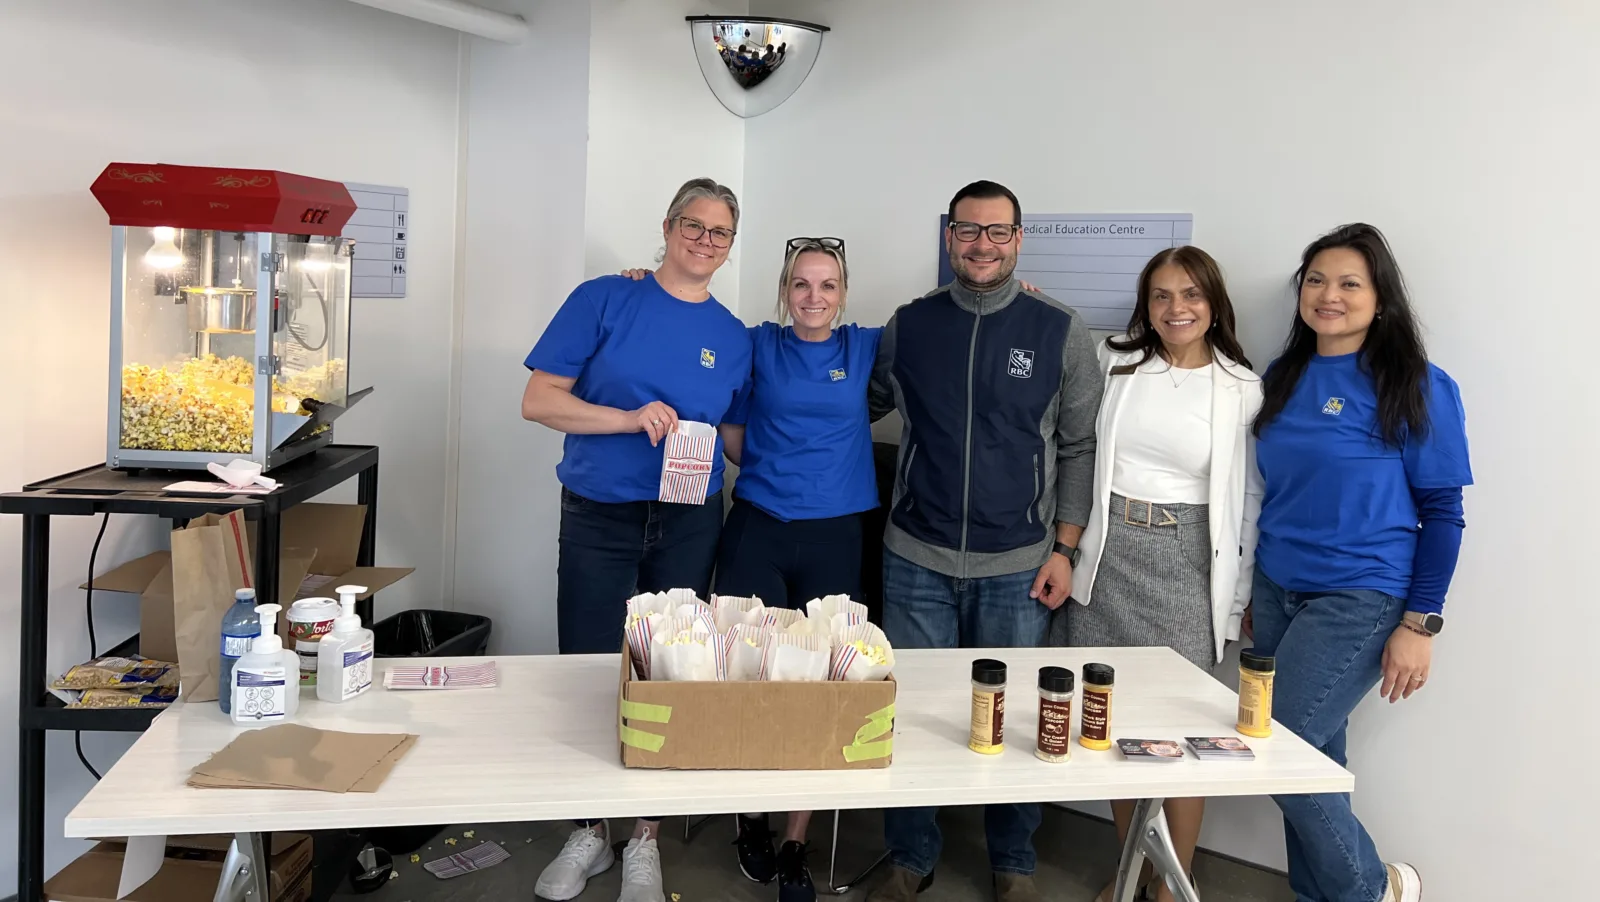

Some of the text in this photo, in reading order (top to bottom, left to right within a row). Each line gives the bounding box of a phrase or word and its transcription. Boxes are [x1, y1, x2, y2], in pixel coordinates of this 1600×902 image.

[1022, 223, 1146, 235] edical Education Centre
[1010, 367, 1030, 377] RBC
[667, 461, 712, 471] POPCORN
